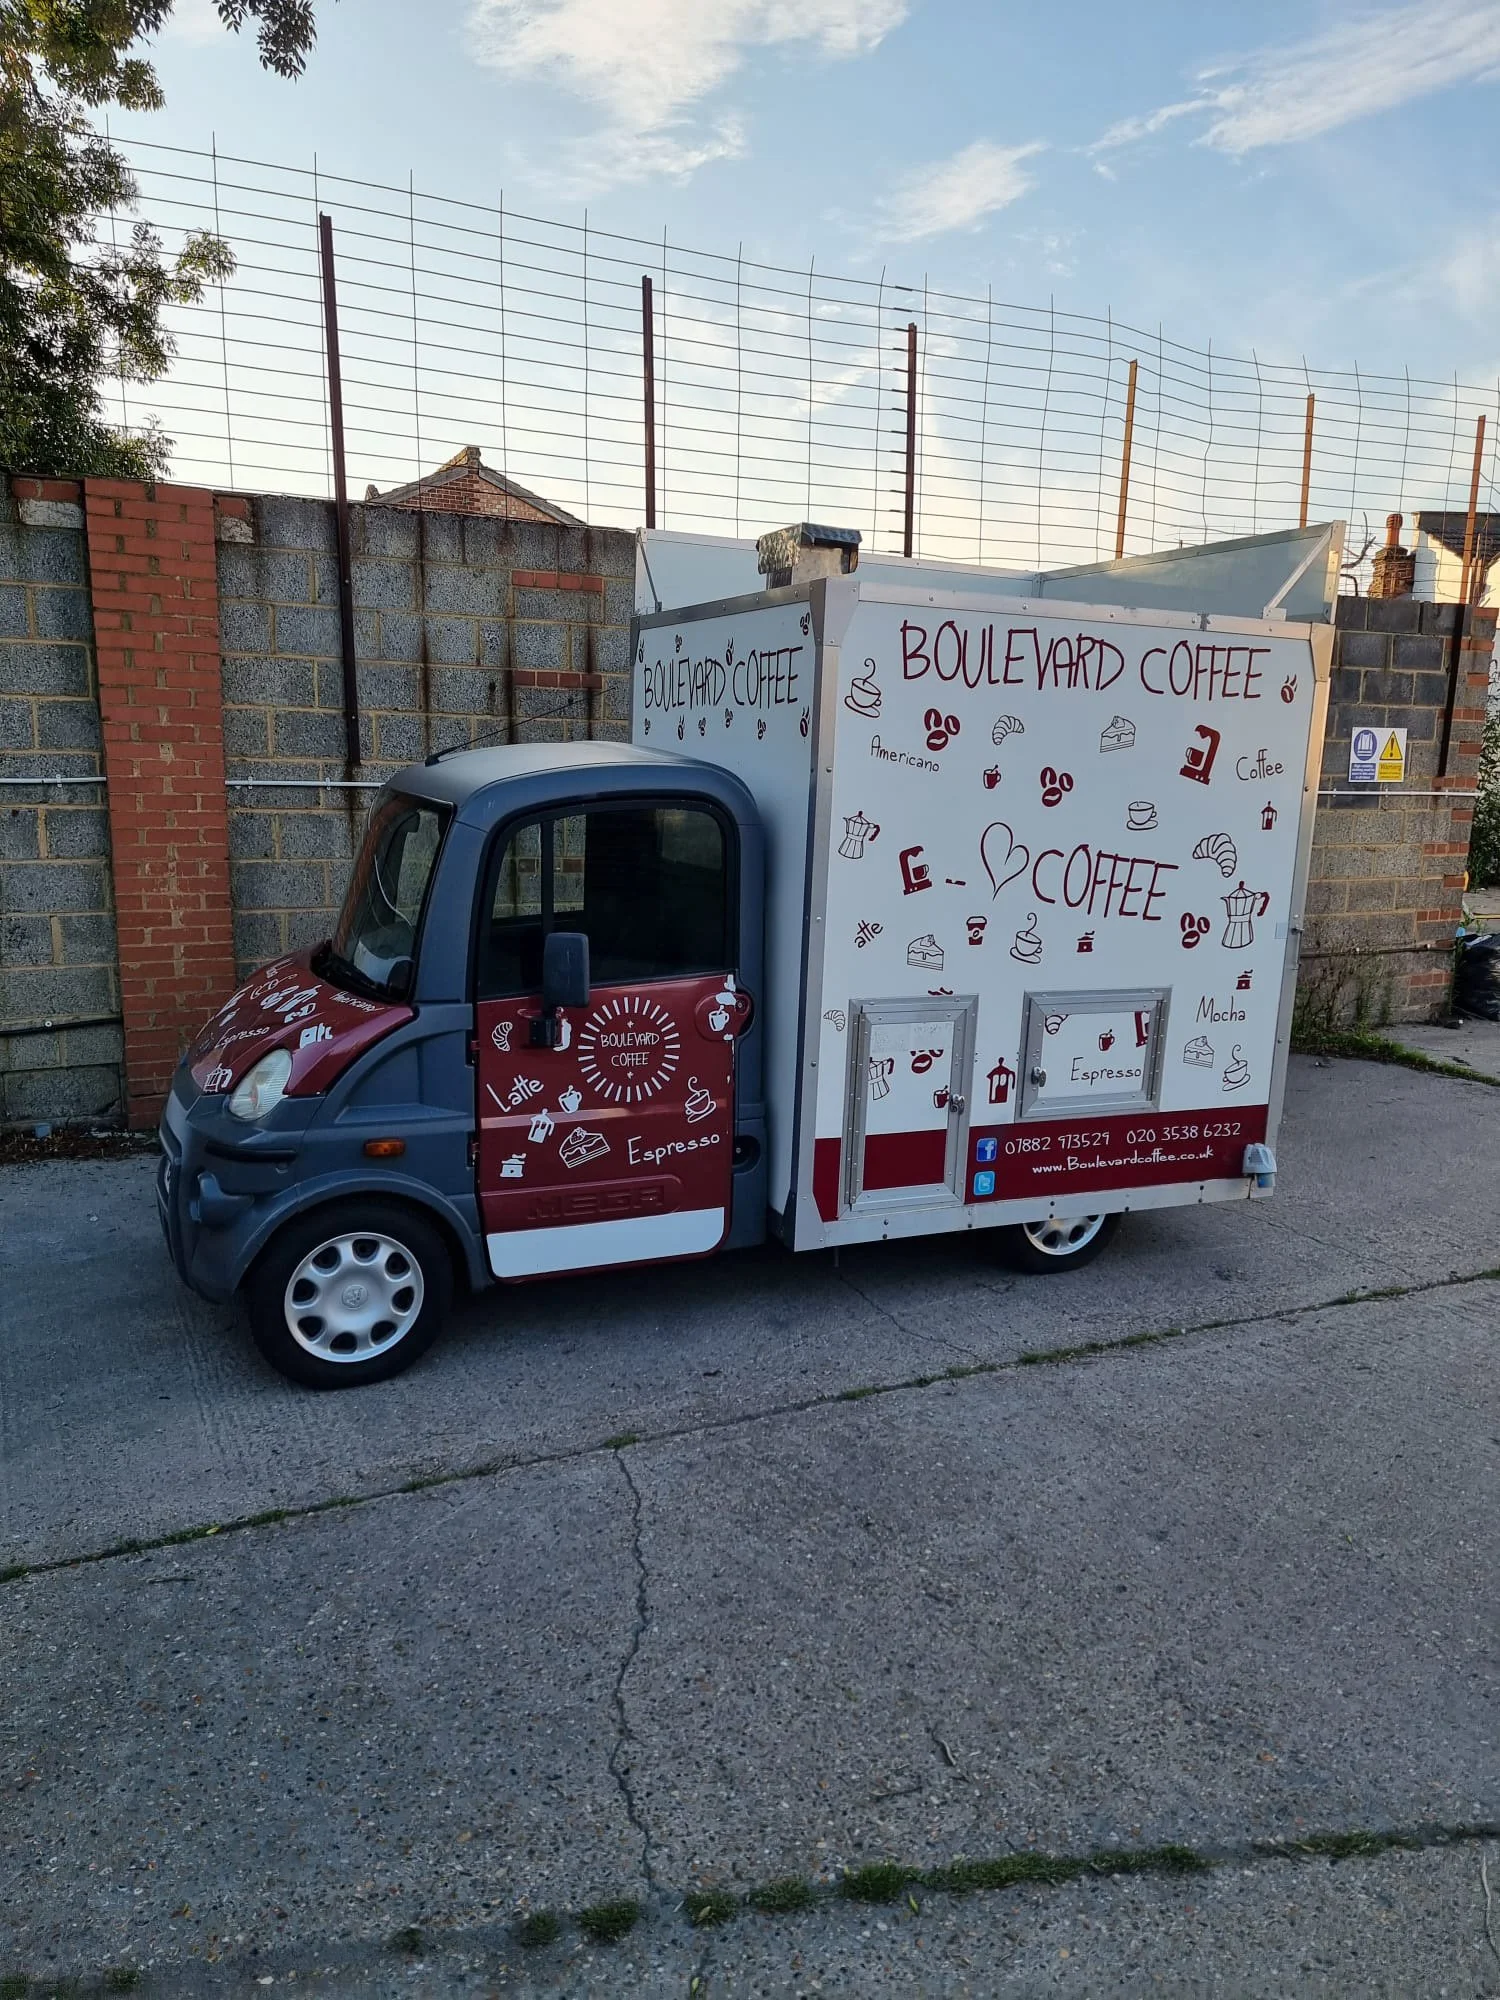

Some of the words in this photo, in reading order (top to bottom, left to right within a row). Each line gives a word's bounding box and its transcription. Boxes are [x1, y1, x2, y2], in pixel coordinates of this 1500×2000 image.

[900, 620, 1125, 690] BOULEVARD
[1140, 640, 1271, 701] COFFEE
[643, 656, 726, 712] BOULEVARD
[732, 646, 803, 709] COFFEE
[870, 734, 940, 773] Americano
[1236, 749, 1284, 782] Coffee
[1032, 843, 1179, 920] COFFEE
[1196, 995, 1246, 1023] Mocha
[600, 1032, 660, 1048] BOULEVARD
[611, 1052, 650, 1067] COFFEE
[1070, 1056, 1142, 1086] Espresso
[486, 1074, 544, 1113] Latte
[627, 1133, 720, 1165] Espresso
[1005, 1136, 1051, 1155] 07882
[1058, 1131, 1110, 1150] 973529
[1126, 1129, 1156, 1144] 020
[1161, 1125, 1199, 1141] 3538
[1203, 1122, 1241, 1138] 6232
[1032, 1144, 1214, 1174] www.Boulevardcoffee.co.uk
